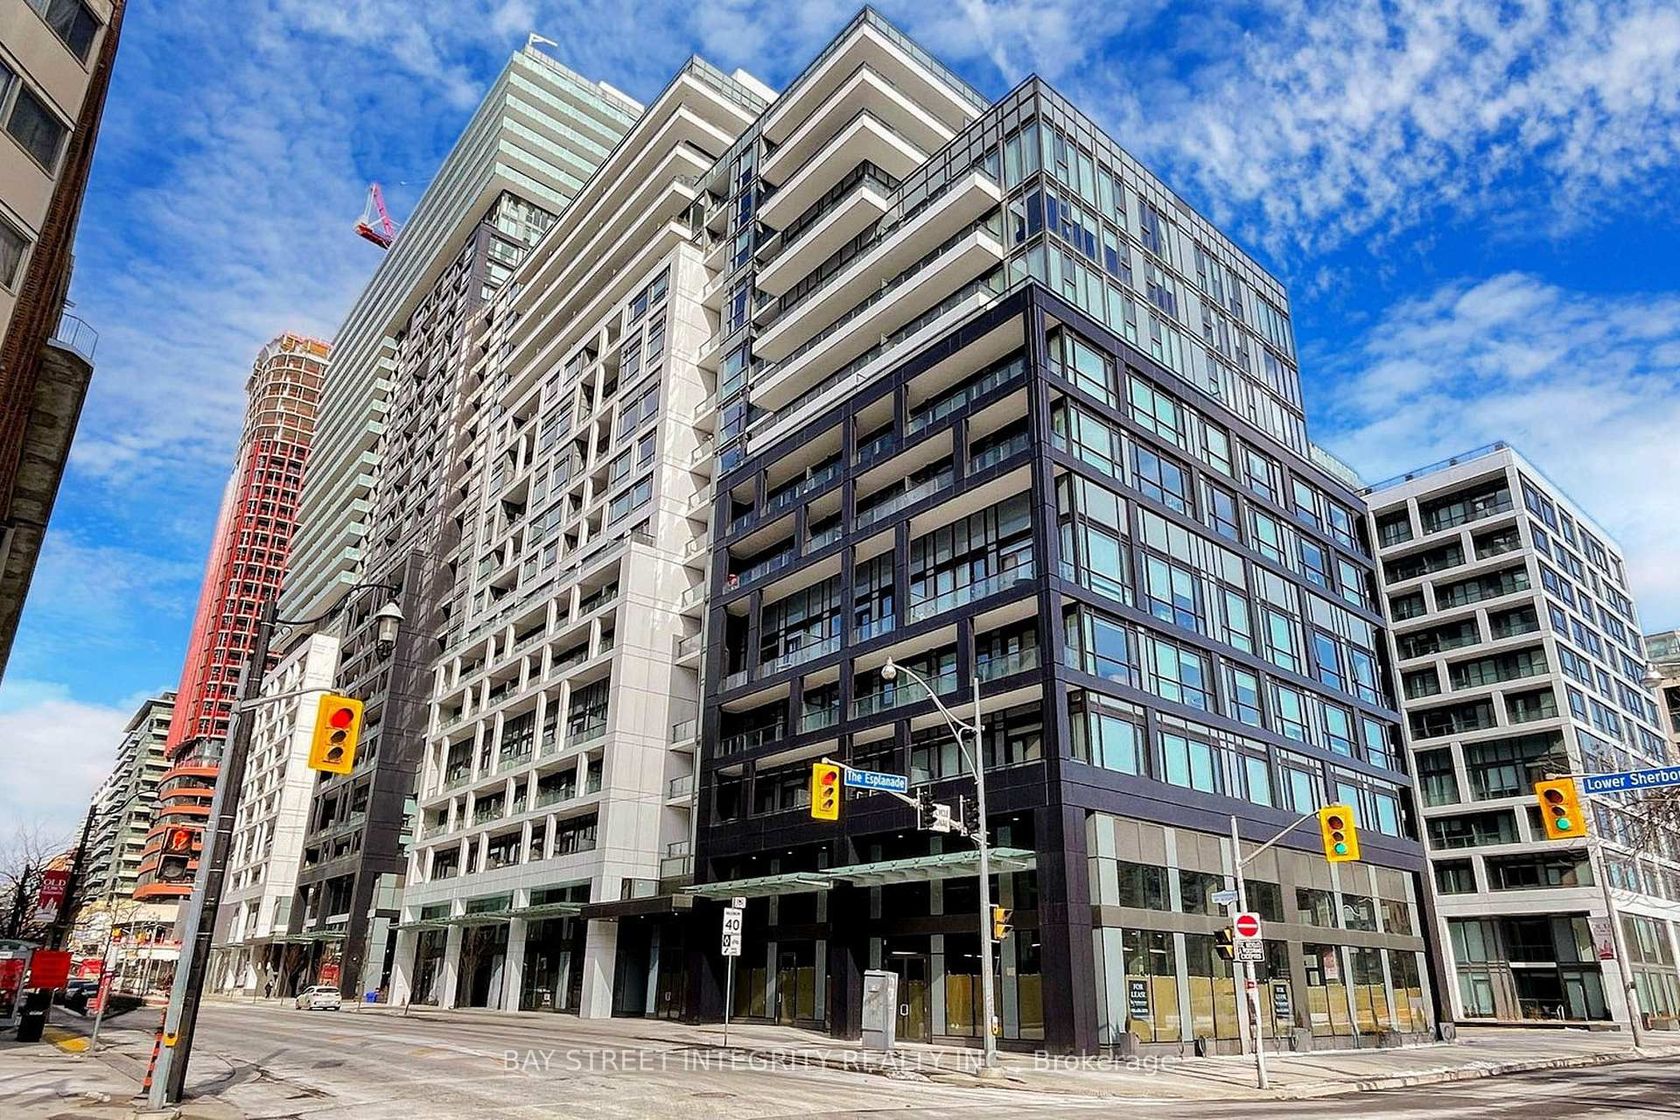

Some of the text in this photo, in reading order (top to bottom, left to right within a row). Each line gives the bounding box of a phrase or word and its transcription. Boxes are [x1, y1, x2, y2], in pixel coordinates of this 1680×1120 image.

[847, 770, 905, 788] The Esplanade
[1587, 770, 1680, 790] Lower Sherbo
[725, 919, 740, 931] 40
